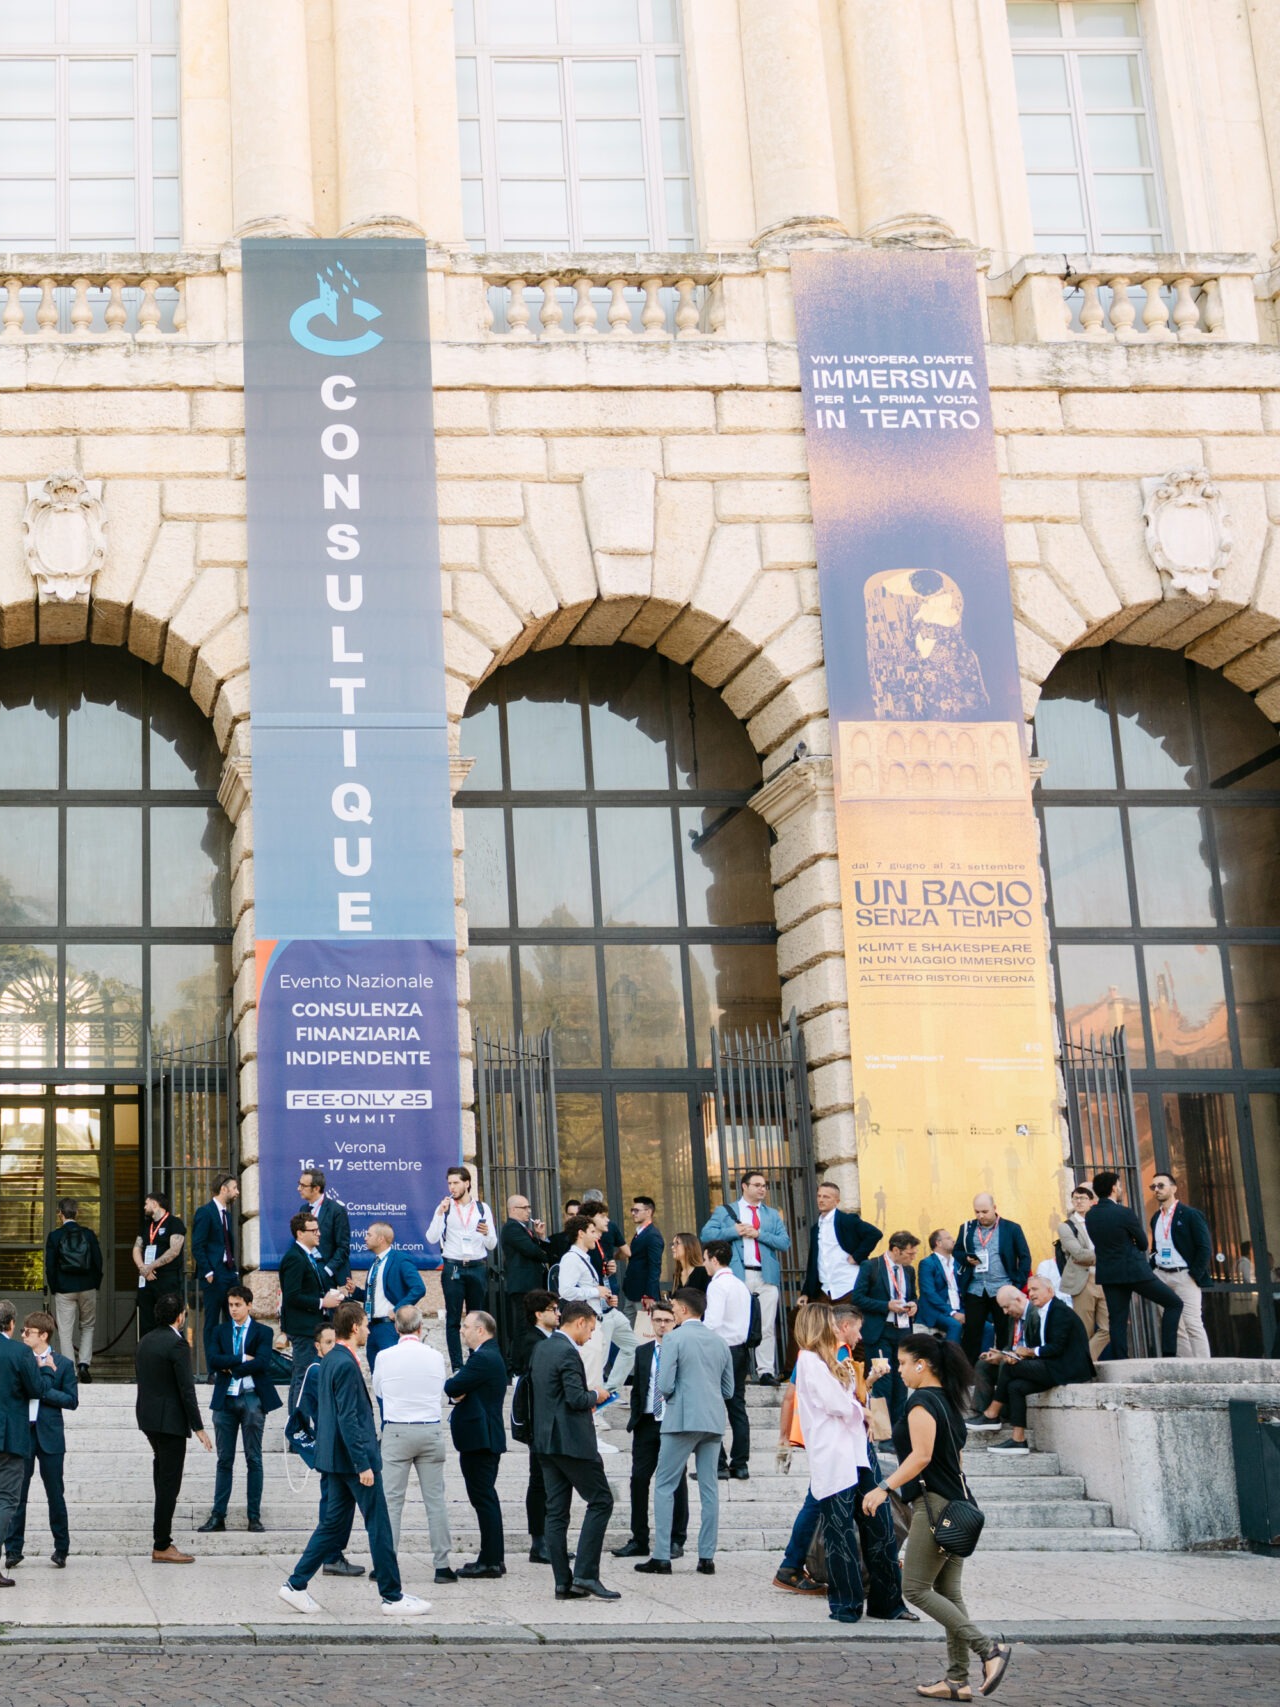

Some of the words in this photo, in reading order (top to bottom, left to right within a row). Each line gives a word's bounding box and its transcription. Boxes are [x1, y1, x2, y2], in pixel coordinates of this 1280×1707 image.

[810, 355, 838, 364] VIVI
[843, 355, 919, 365] UN'OPERA
[923, 355, 974, 365] D'ARTE
[812, 369, 977, 390] IMMERSIVA
[814, 395, 844, 404] PER
[852, 394, 872, 404] LA
[879, 394, 926, 404] PRIMA
[933, 395, 978, 405] VOLTA
[816, 409, 846, 429] IN
[860, 409, 981, 430] TEATRO
[320, 375, 373, 932] CONSULTIQUE
[851, 861, 869, 870] dal
[889, 861, 926, 871] giugno
[933, 862, 943, 870] al
[967, 862, 1026, 870] settembre
[854, 879, 908, 906] UN
[922, 880, 1033, 907] BACIO
[856, 908, 940, 927] SENZA
[947, 908, 1033, 928] TEMPO
[858, 942, 904, 952] KLIMT
[908, 942, 917, 952] E
[921, 943, 1033, 953] SHAKESPEARE
[859, 956, 873, 965] IN
[877, 955, 897, 965] UN
[900, 956, 957, 965] VIAGGIO
[960, 956, 1036, 966] IMMERSIVO
[280, 974, 341, 989] Evento
[347, 973, 434, 989] Nazionale
[860, 974, 875, 982] AL
[878, 974, 923, 982] TEATRO
[926, 974, 970, 982] RISTORI
[973, 975, 983, 983] DI
[985, 975, 1035, 983] VERONA
[291, 1002, 423, 1017] CONSULENZA
[296, 1026, 420, 1041] FINANZIARIA
[286, 1050, 431, 1065] INDIPENDENTE
[292, 1093, 395, 1107] FEE-ONLY
[324, 1114, 396, 1124] SUMMIT
[334, 1141, 386, 1154] Verona
[299, 1159, 315, 1171] 16
[328, 1159, 344, 1171] 17
[346, 1158, 422, 1171] settembre
[347, 1202, 407, 1212] Consultique
